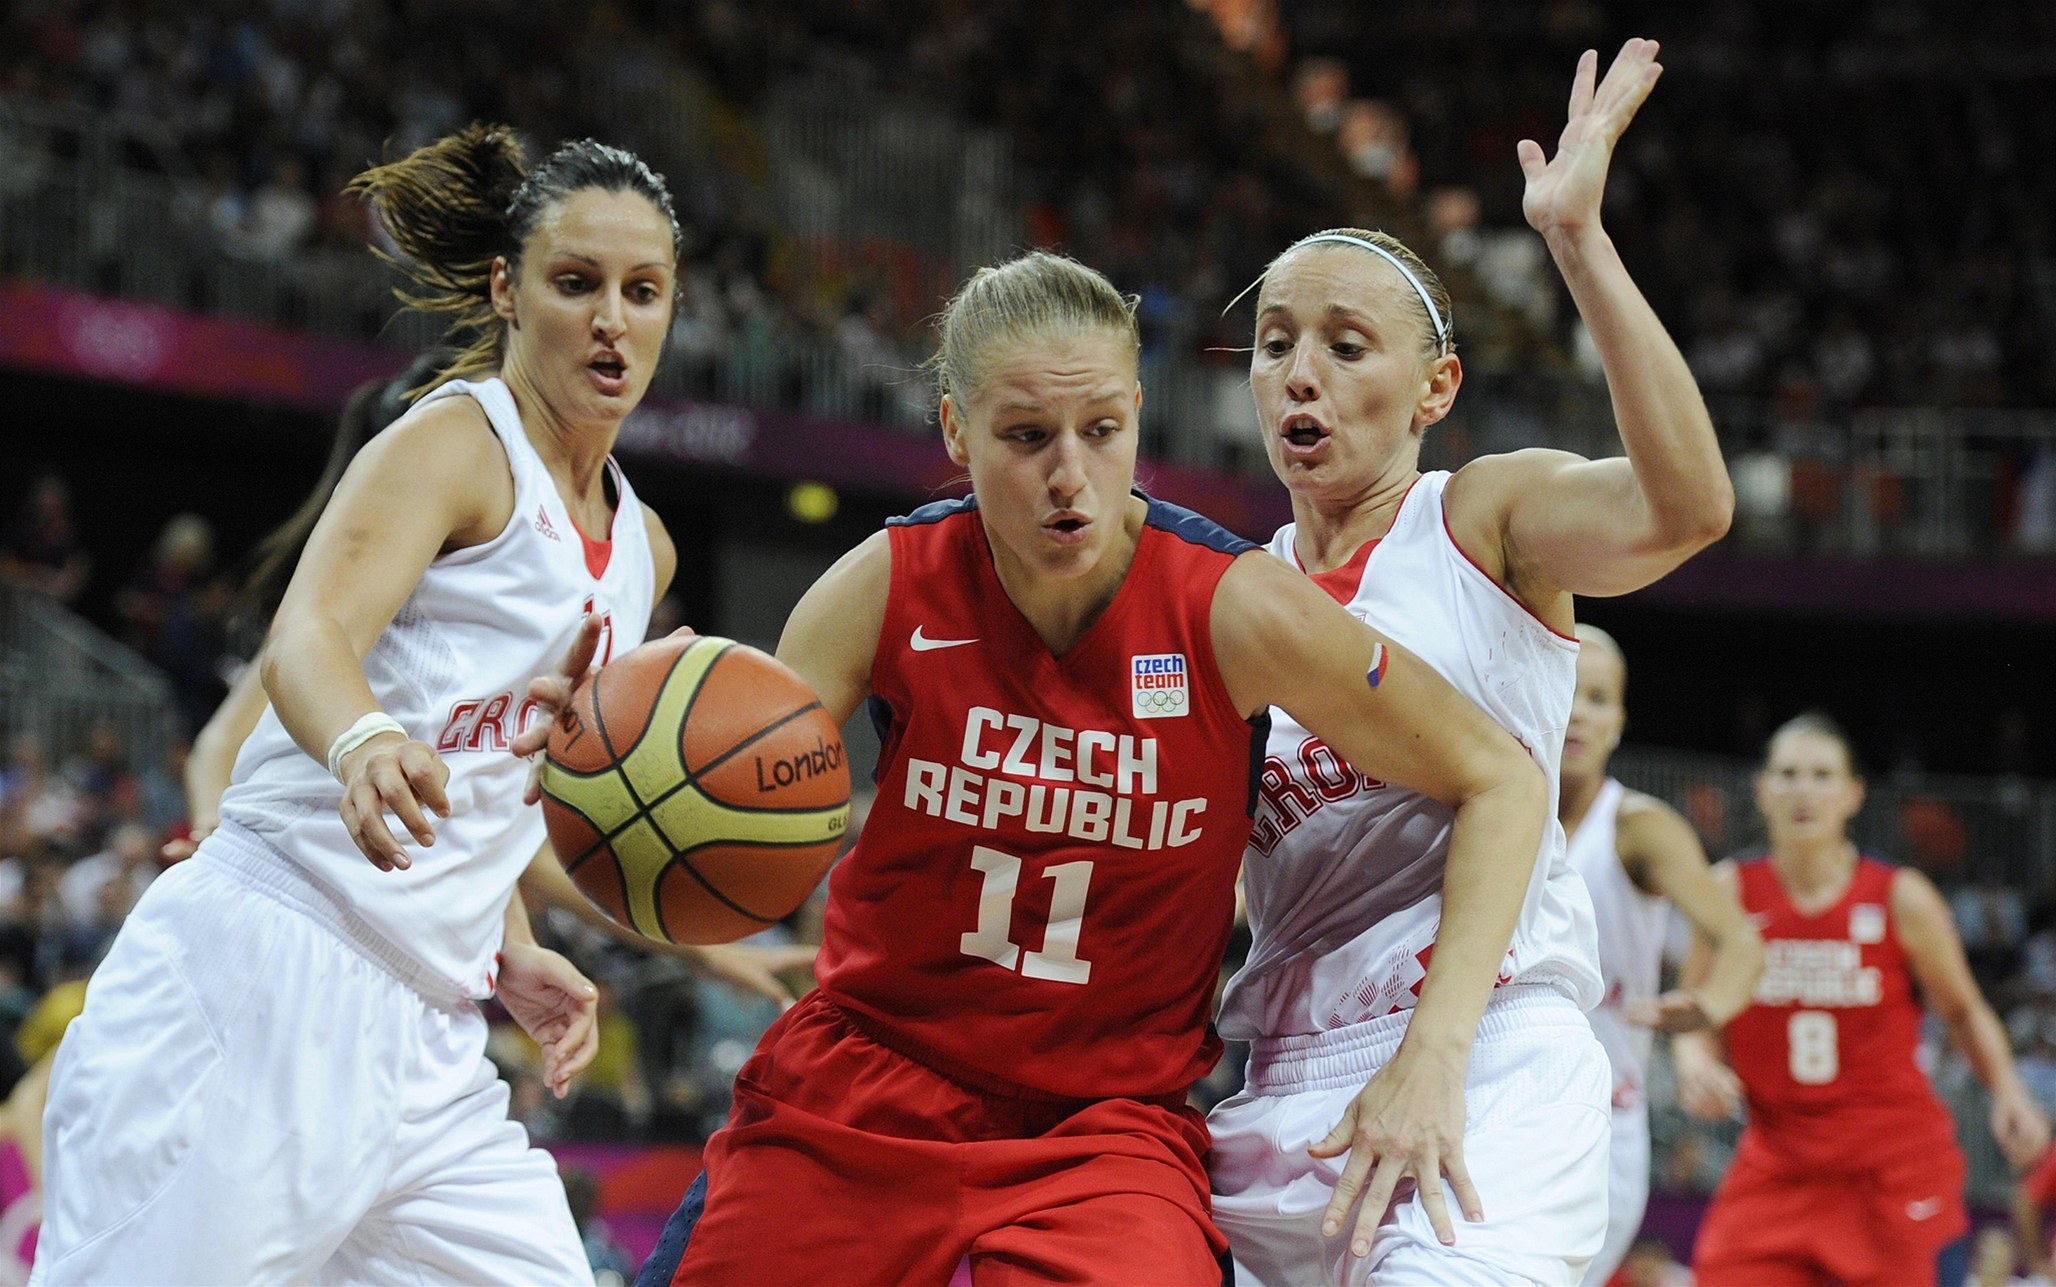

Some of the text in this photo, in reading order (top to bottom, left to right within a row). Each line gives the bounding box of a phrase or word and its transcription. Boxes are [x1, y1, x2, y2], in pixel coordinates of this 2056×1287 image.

[1135, 655, 1183, 674] czech
[1135, 673, 1184, 690] team
[960, 706, 1158, 795] CZECH
[903, 757, 1208, 851] REPUBLIC
[959, 845, 1094, 985] 11
[1788, 1010, 1840, 1086] 8
